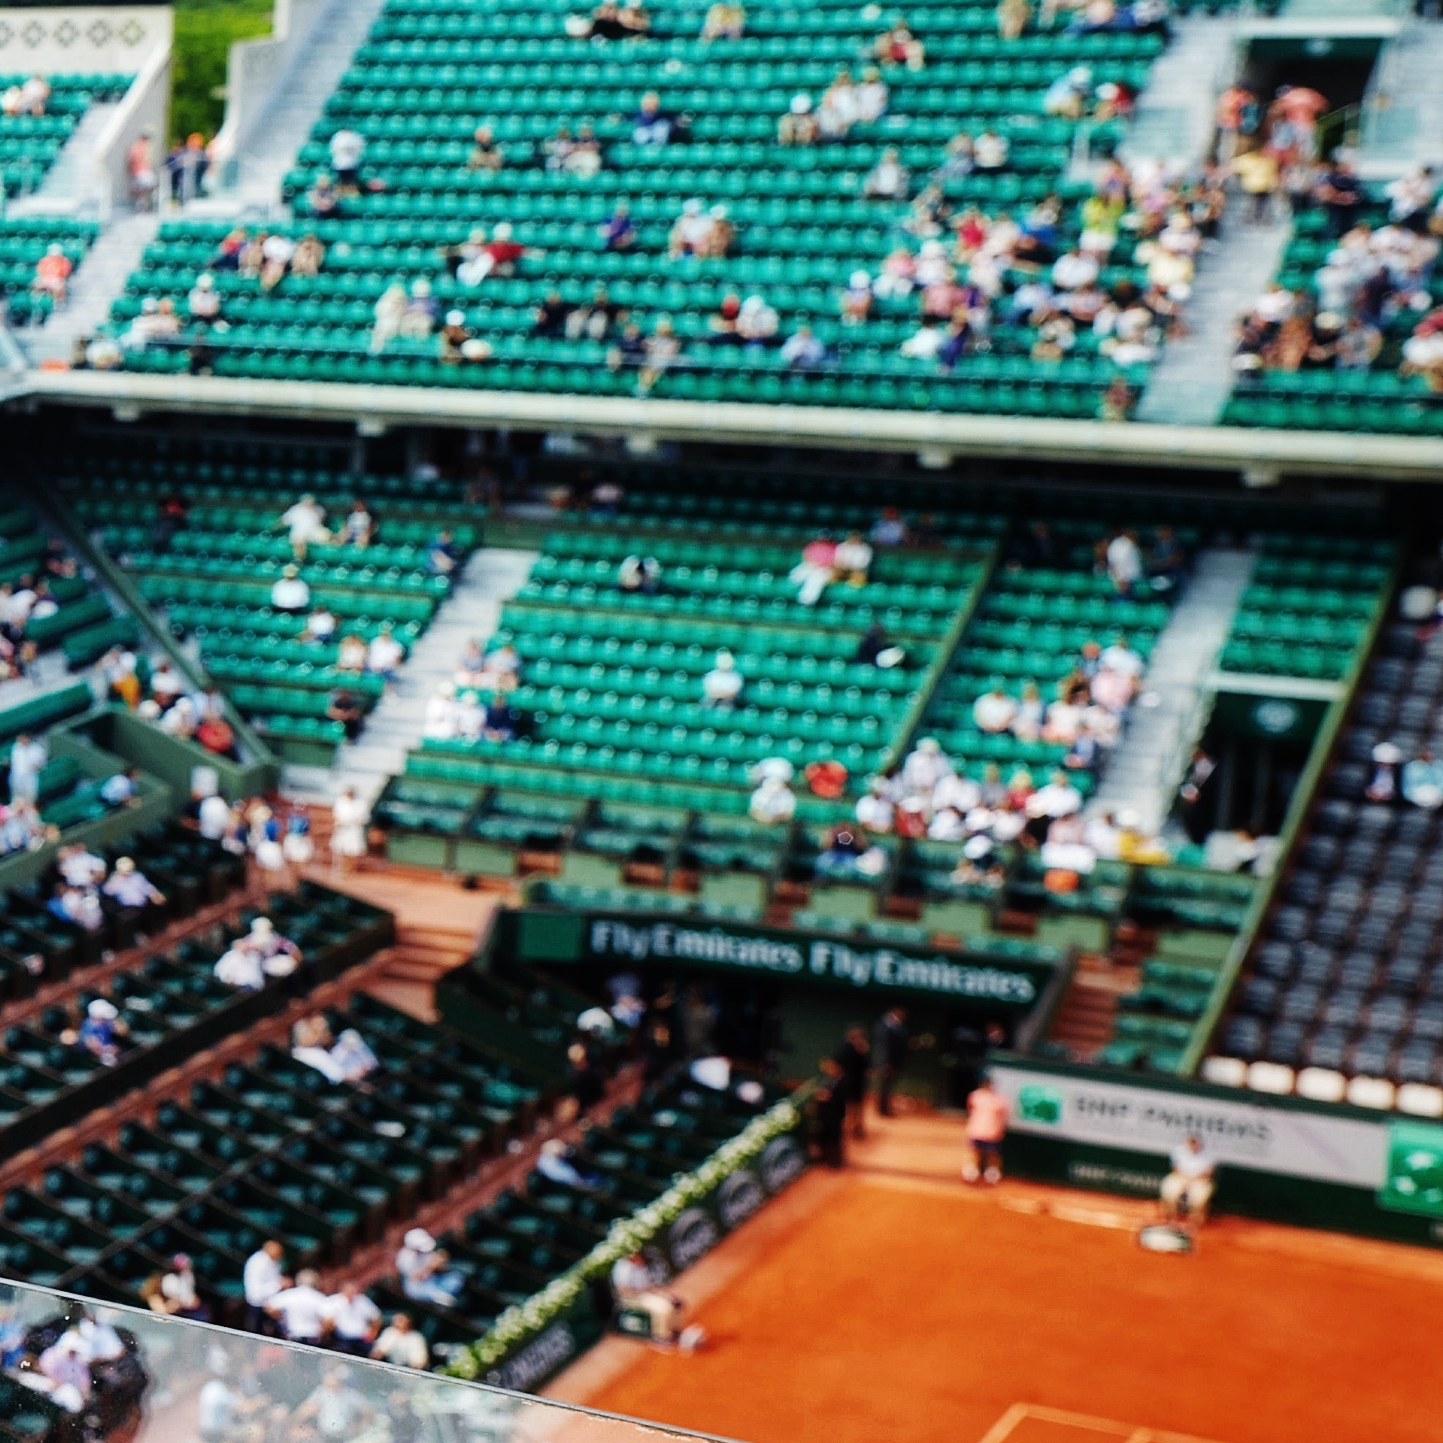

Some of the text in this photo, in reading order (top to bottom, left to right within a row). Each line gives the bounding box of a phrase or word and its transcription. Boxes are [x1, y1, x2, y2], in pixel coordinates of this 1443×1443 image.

[591, 919, 1037, 1005] Fly Emirates Fly Emirates
